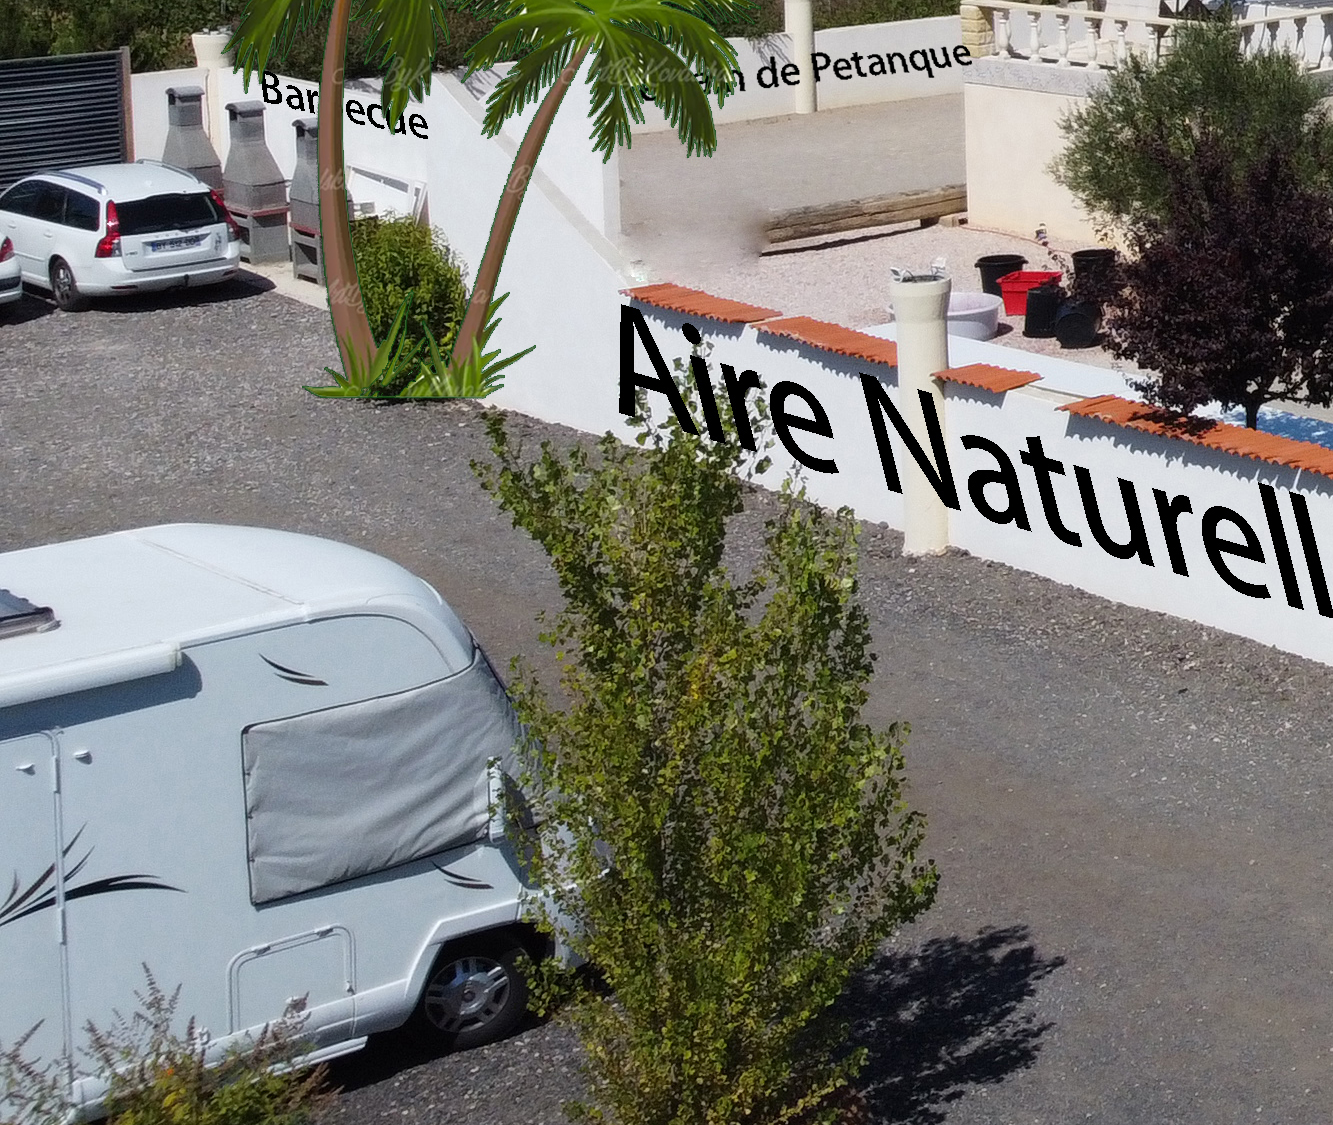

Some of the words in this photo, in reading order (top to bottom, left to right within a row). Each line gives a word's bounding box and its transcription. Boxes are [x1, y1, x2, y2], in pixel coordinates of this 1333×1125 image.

[757, 57, 800, 88] de
[811, 45, 973, 82] Petanque
[262, 70, 429, 140] Barecue
[619, 304, 840, 475] Aire
